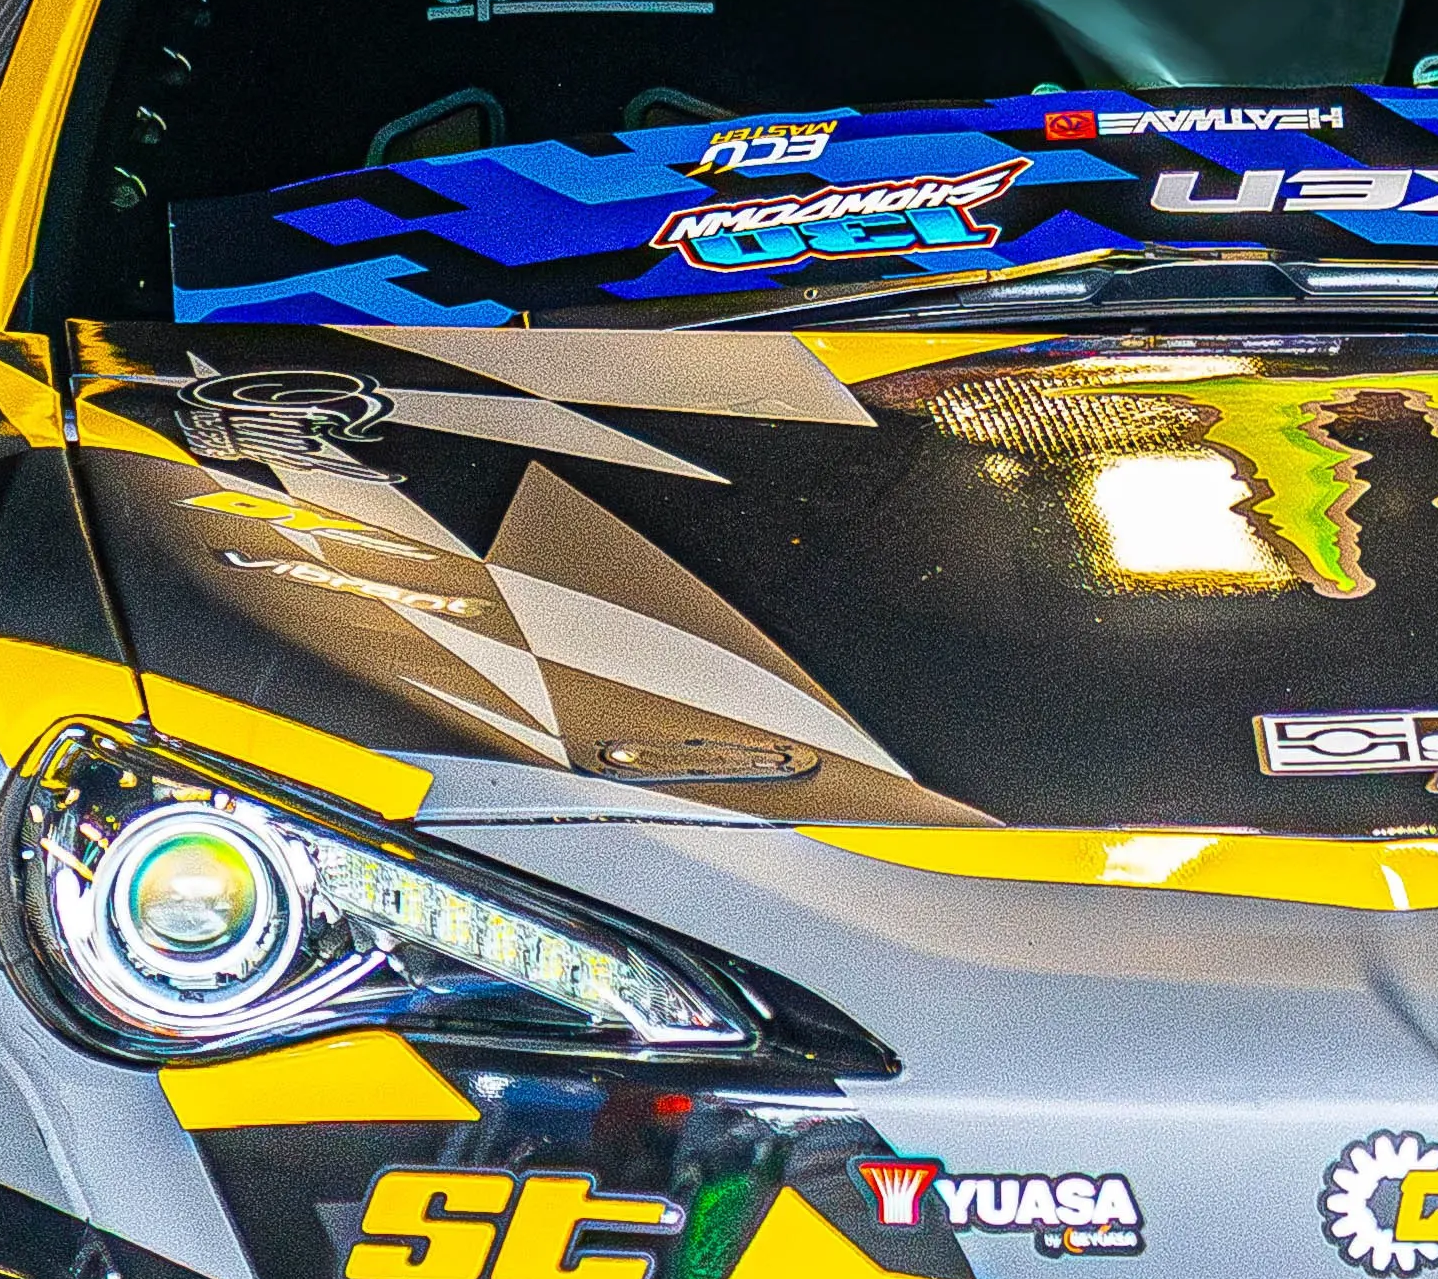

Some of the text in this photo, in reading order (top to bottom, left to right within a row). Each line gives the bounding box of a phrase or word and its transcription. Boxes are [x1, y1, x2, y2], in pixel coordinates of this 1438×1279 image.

[711, 119, 839, 145] MASTER
[1098, 108, 1343, 137] HEATWAVE
[688, 133, 831, 176] ECU
[668, 169, 1013, 241] SHOWDOWN
[933, 1177, 1139, 1225] YUASA
